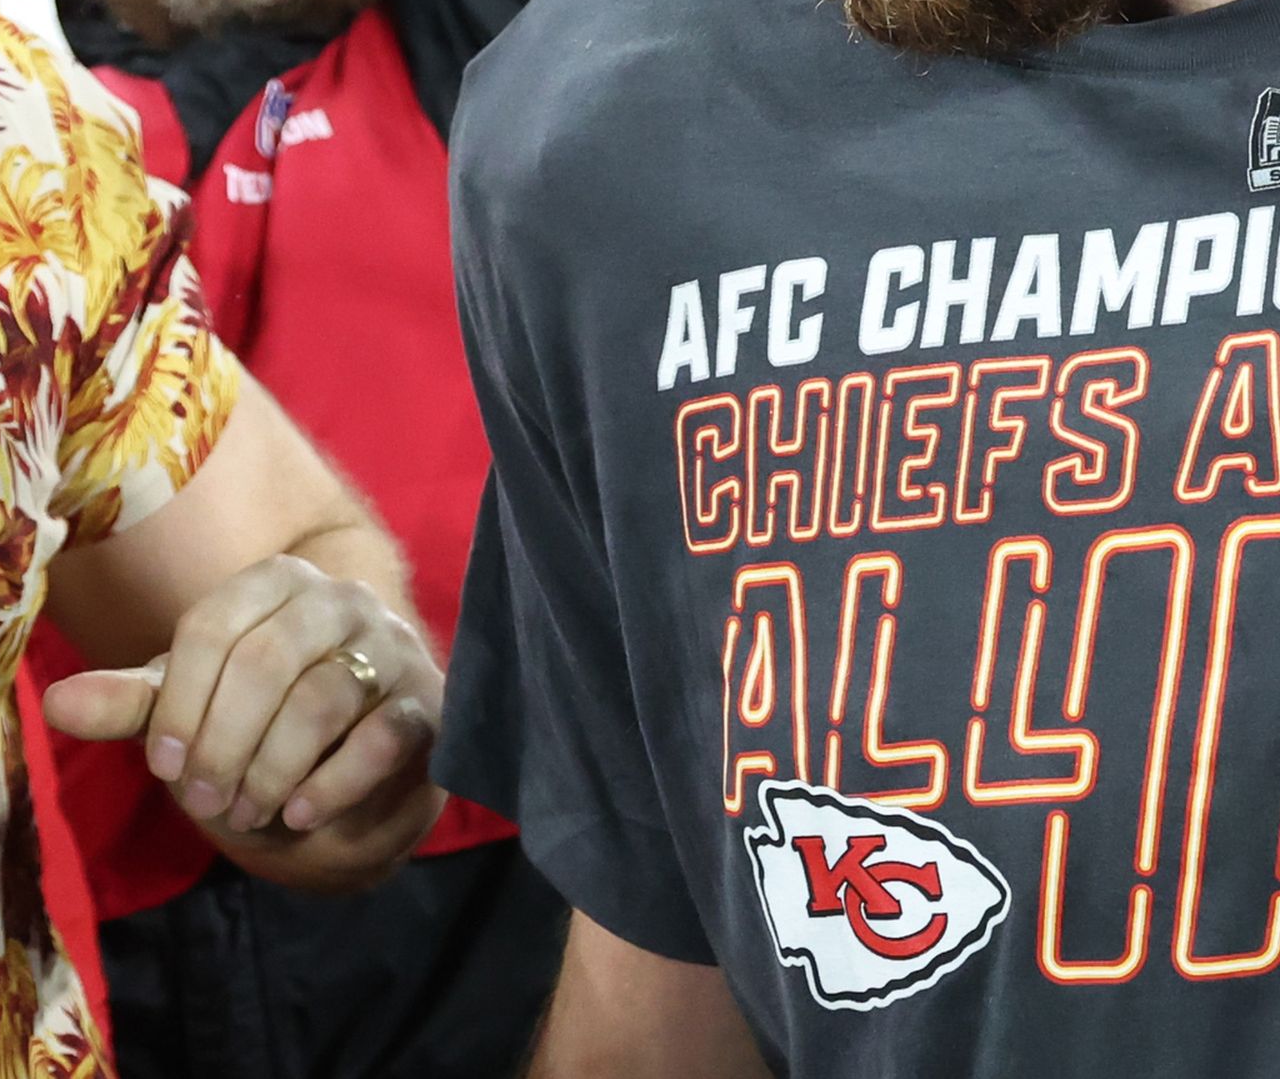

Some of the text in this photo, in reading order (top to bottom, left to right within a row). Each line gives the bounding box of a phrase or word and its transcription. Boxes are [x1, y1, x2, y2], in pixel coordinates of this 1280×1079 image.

[657, 256, 828, 391] AFC
[676, 346, 1149, 554] CHIEFS
[722, 536, 1098, 814] ALL
[793, 834, 948, 959] KC
